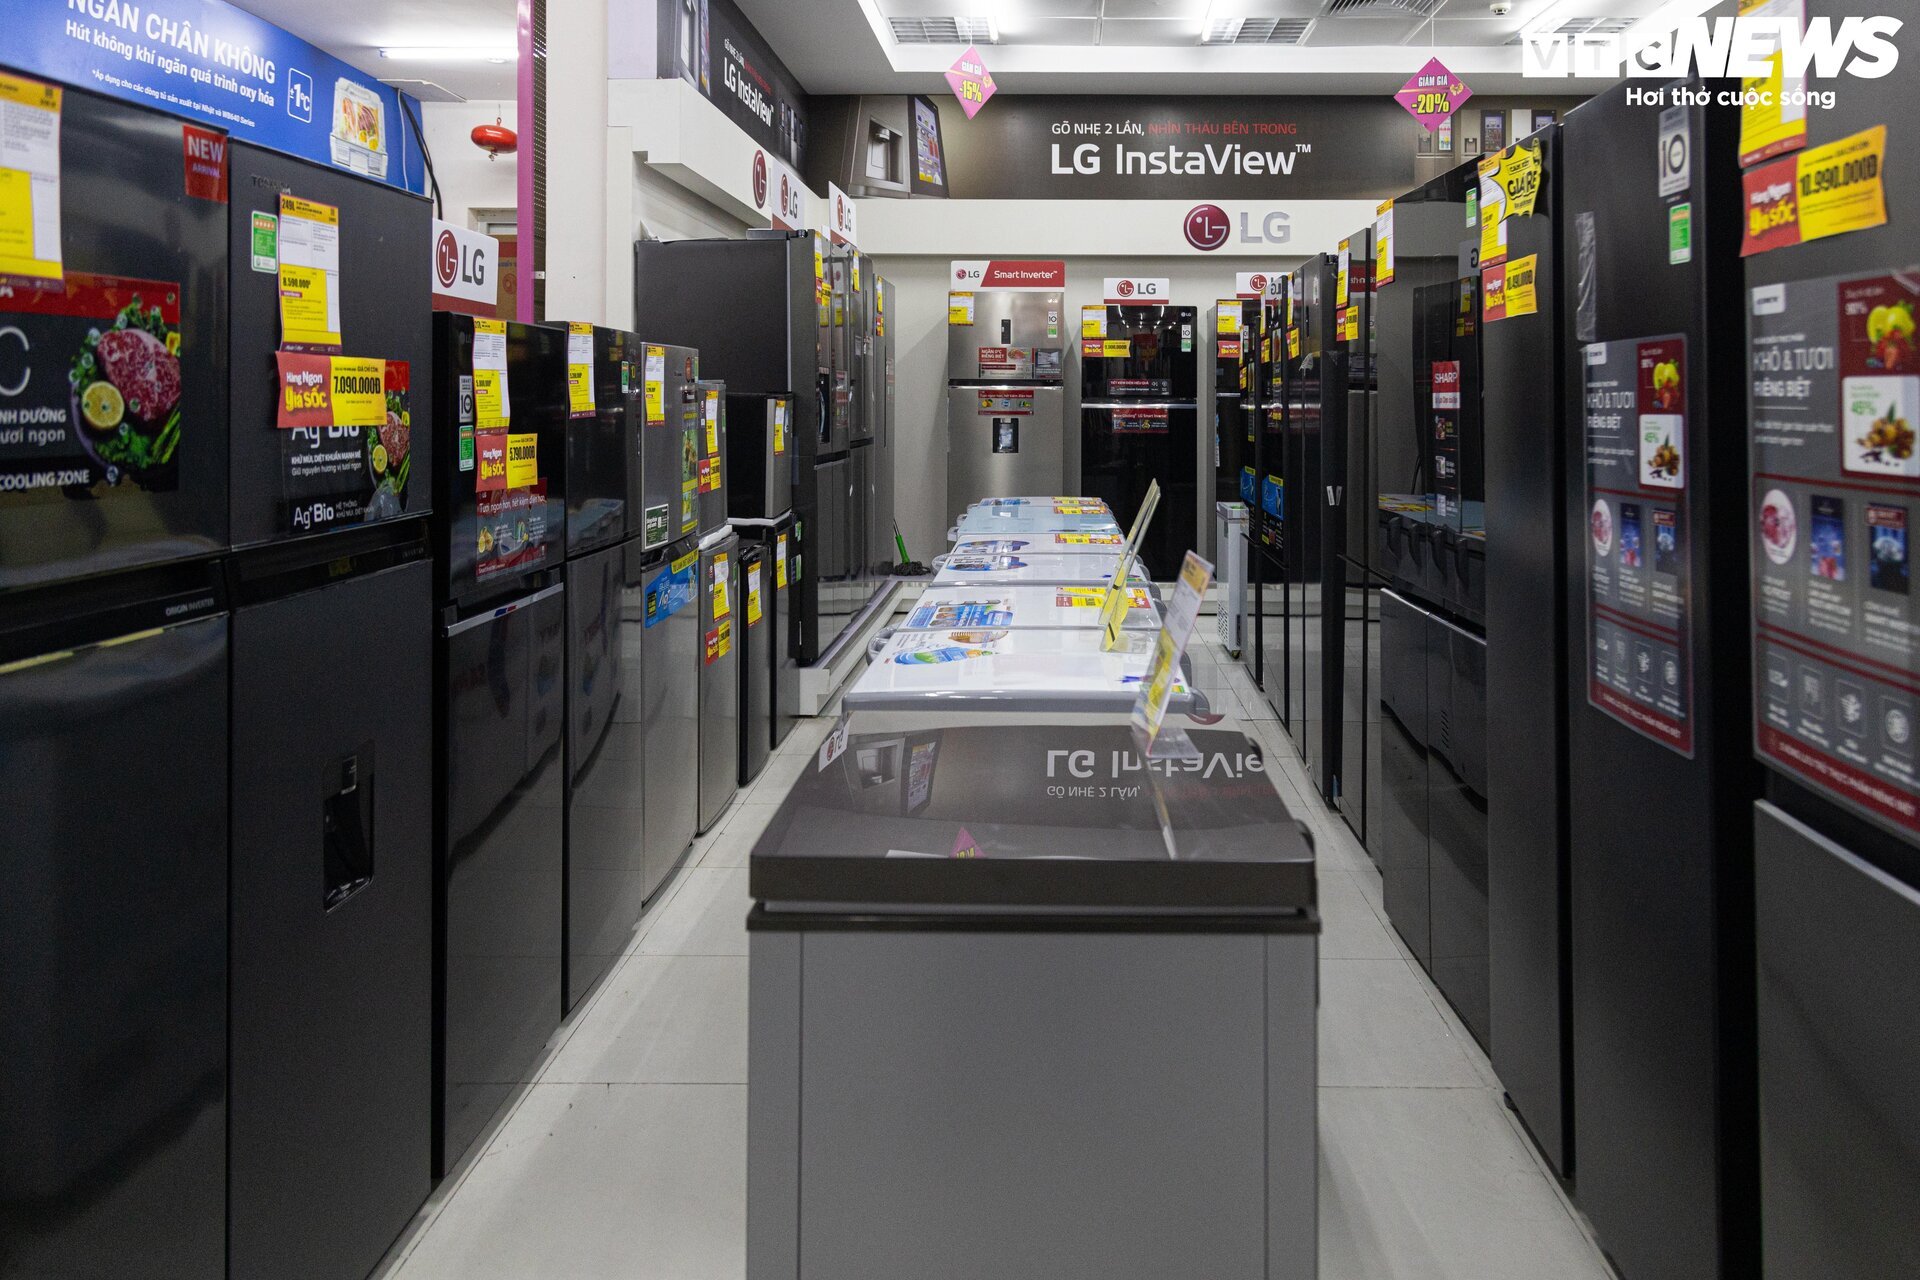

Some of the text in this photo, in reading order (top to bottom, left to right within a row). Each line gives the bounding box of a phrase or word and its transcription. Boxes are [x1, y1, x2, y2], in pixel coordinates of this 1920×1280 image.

[146, 13, 209, 58] CHÂN
[213, 38, 276, 84] KHÔNG
[66, 19, 275, 107] Hút không khí ngăn quá trình oxy hóa
[724, 57, 736, 92] LG
[959, 79, 983, 103] -15%
[1411, 92, 1450, 115] -20%
[1052, 120, 1070, 135] GÕ
[1074, 123, 1101, 136] NHẸ
[1105, 123, 1112, 135] 2
[1116, 119, 1145, 137] LẦN,
[1252, 123, 1297, 134] TRONG
[188, 135, 224, 163] NEW
[1051, 143, 1100, 175] LG
[789, 186, 798, 219] LG
[844, 203, 852, 232] LG
[1240, 211, 1291, 244] LG
[462, 245, 485, 286] LG
[968, 270, 980, 279] LG
[994, 270, 1020, 279] Smart
[1137, 283, 1156, 295] LG
[302, 370, 323, 386] Ngon
[1435, 372, 1458, 384] SHARP
[28, 430, 65, 446] ngon
[0, 468, 90, 491] COOLING ZONE
